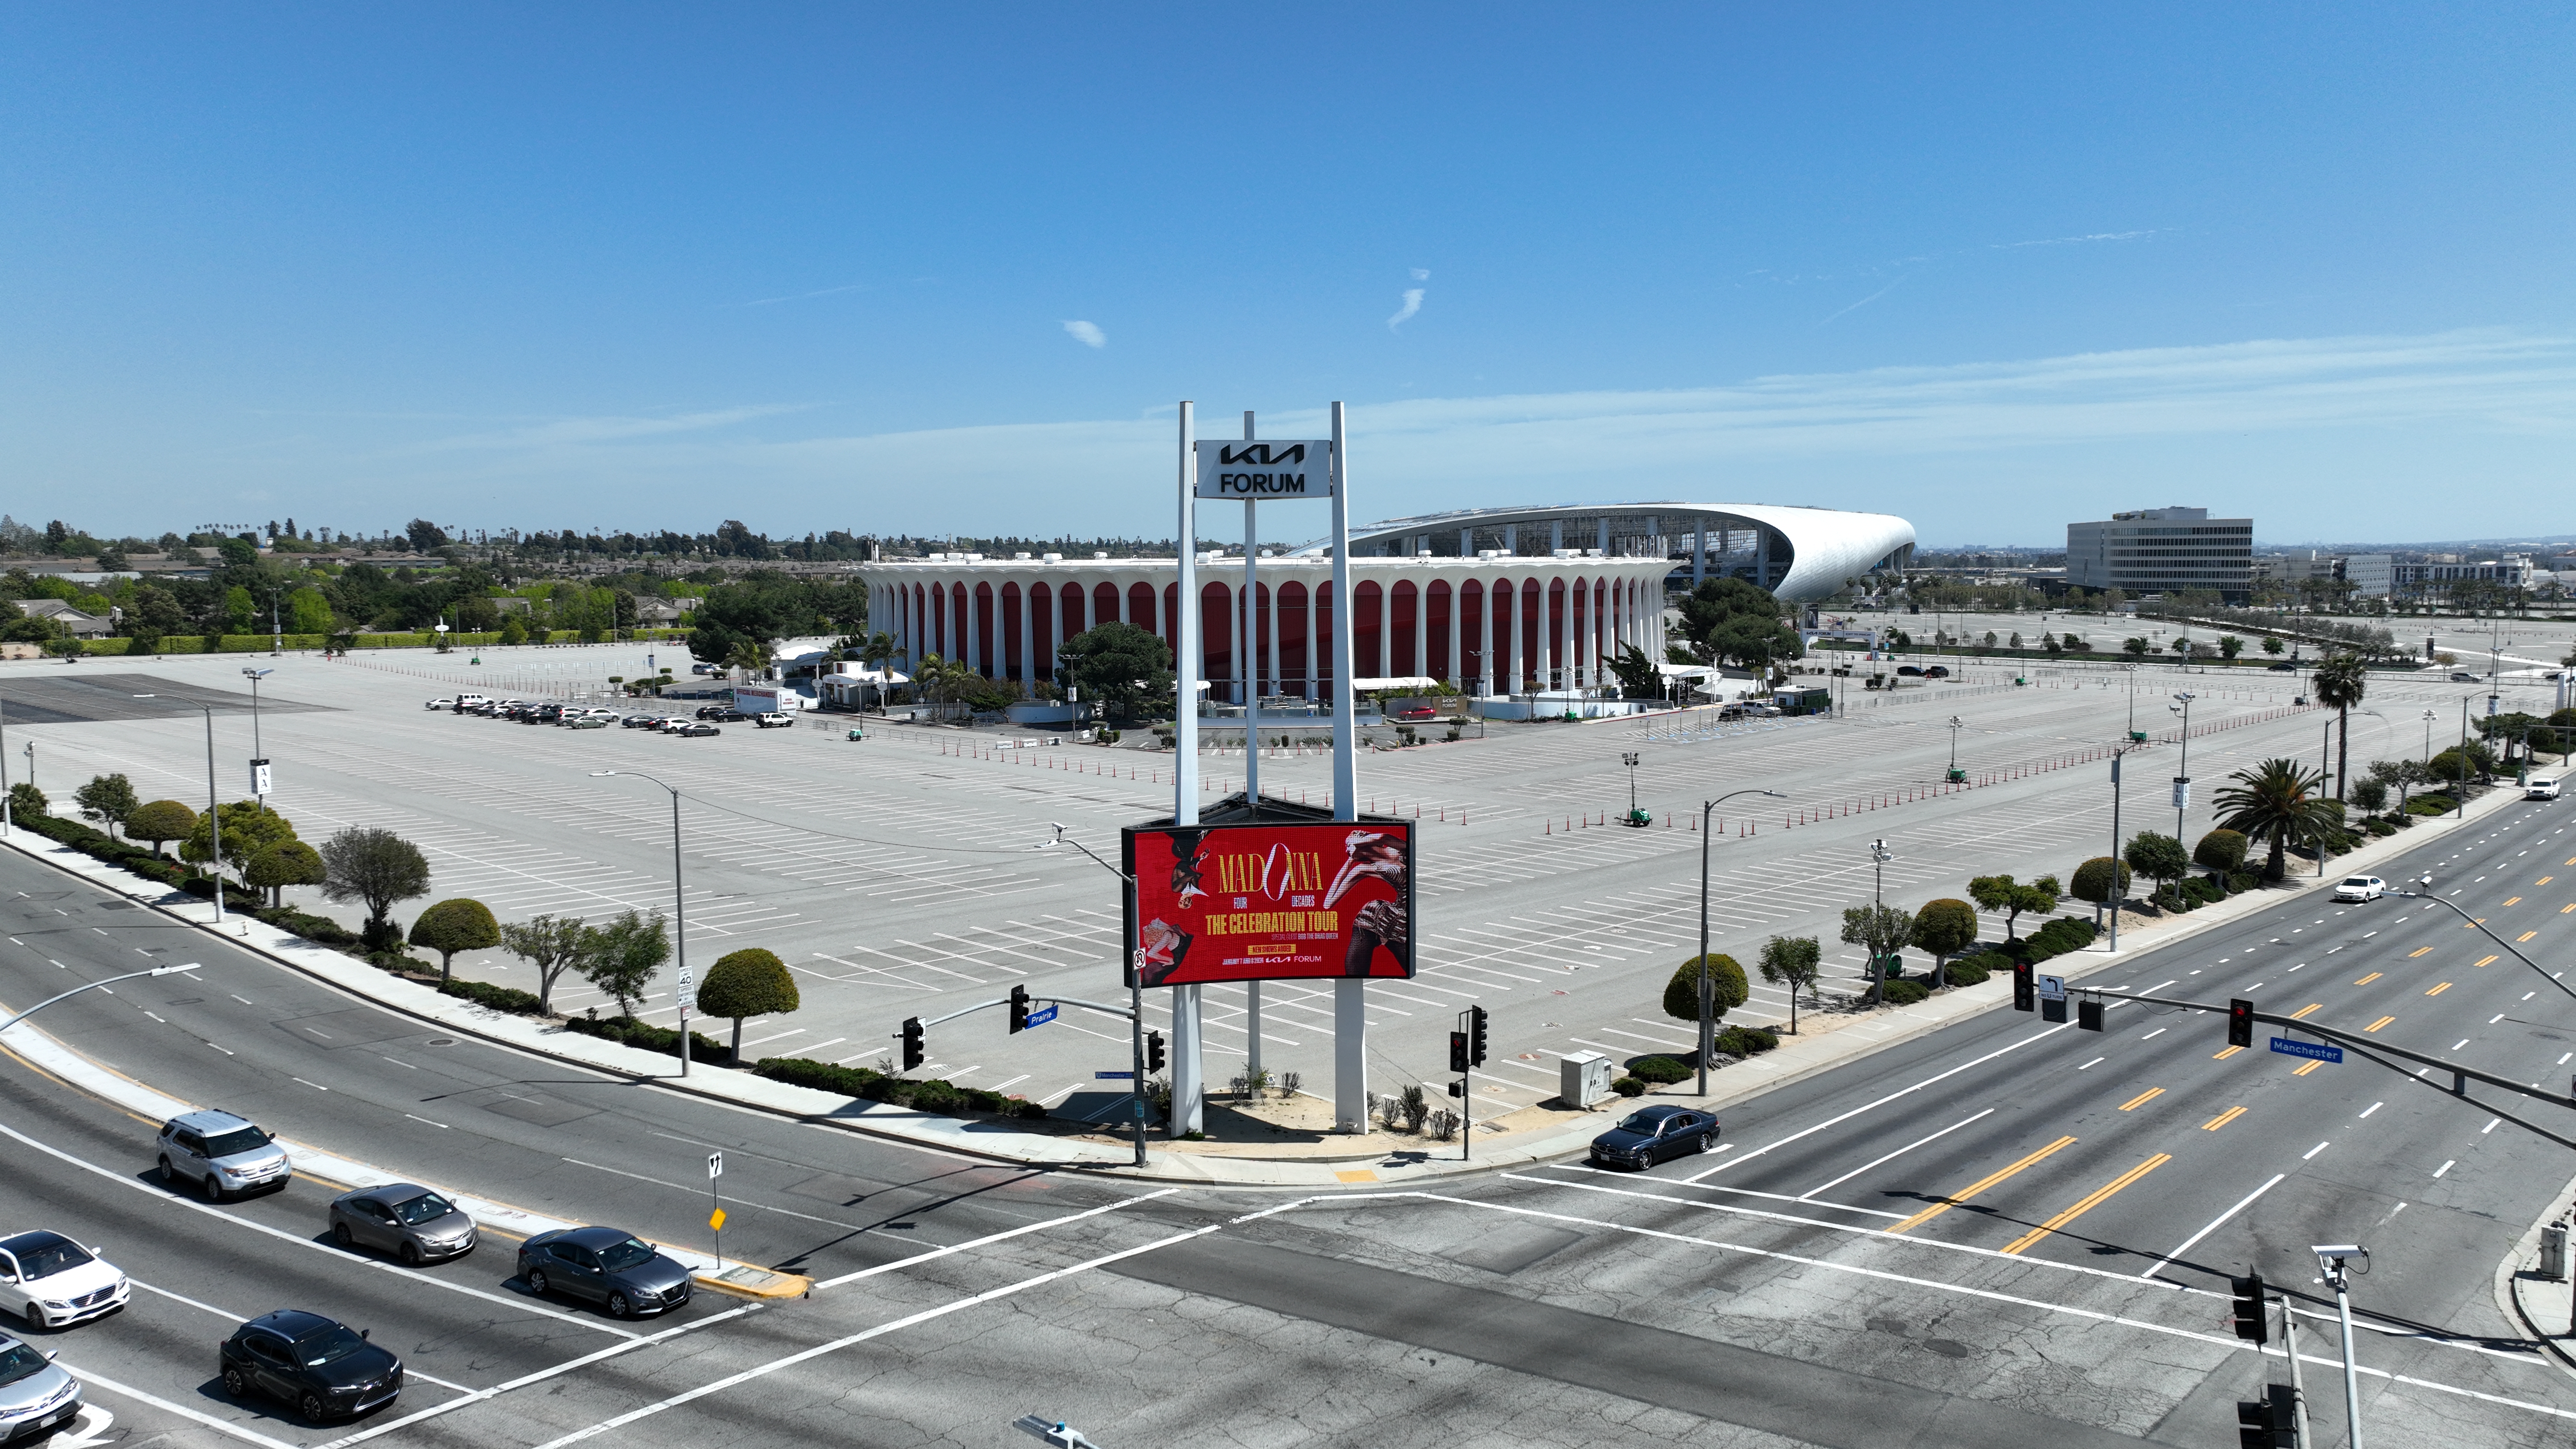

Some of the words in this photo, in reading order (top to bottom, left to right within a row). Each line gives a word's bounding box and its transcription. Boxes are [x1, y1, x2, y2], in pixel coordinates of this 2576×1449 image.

[1221, 444, 1304, 464] KIA
[1221, 474, 1304, 492] FORUM
[751, 689, 776, 698] MERCHANDISE
[260, 768, 267, 777] A
[261, 780, 267, 788] A
[1218, 843, 1323, 901] MADONNA
[1234, 897, 1247, 909] FOUR
[1291, 895, 1315, 907] DECADES
[1206, 914, 1227, 935] THE
[1229, 911, 1305, 934] CELEBRATION
[1307, 911, 1338, 931] TOUR
[680, 976, 691, 985] 40
[1031, 1011, 1052, 1024] Prairie
[2274, 1041, 2338, 1059] Manchester
